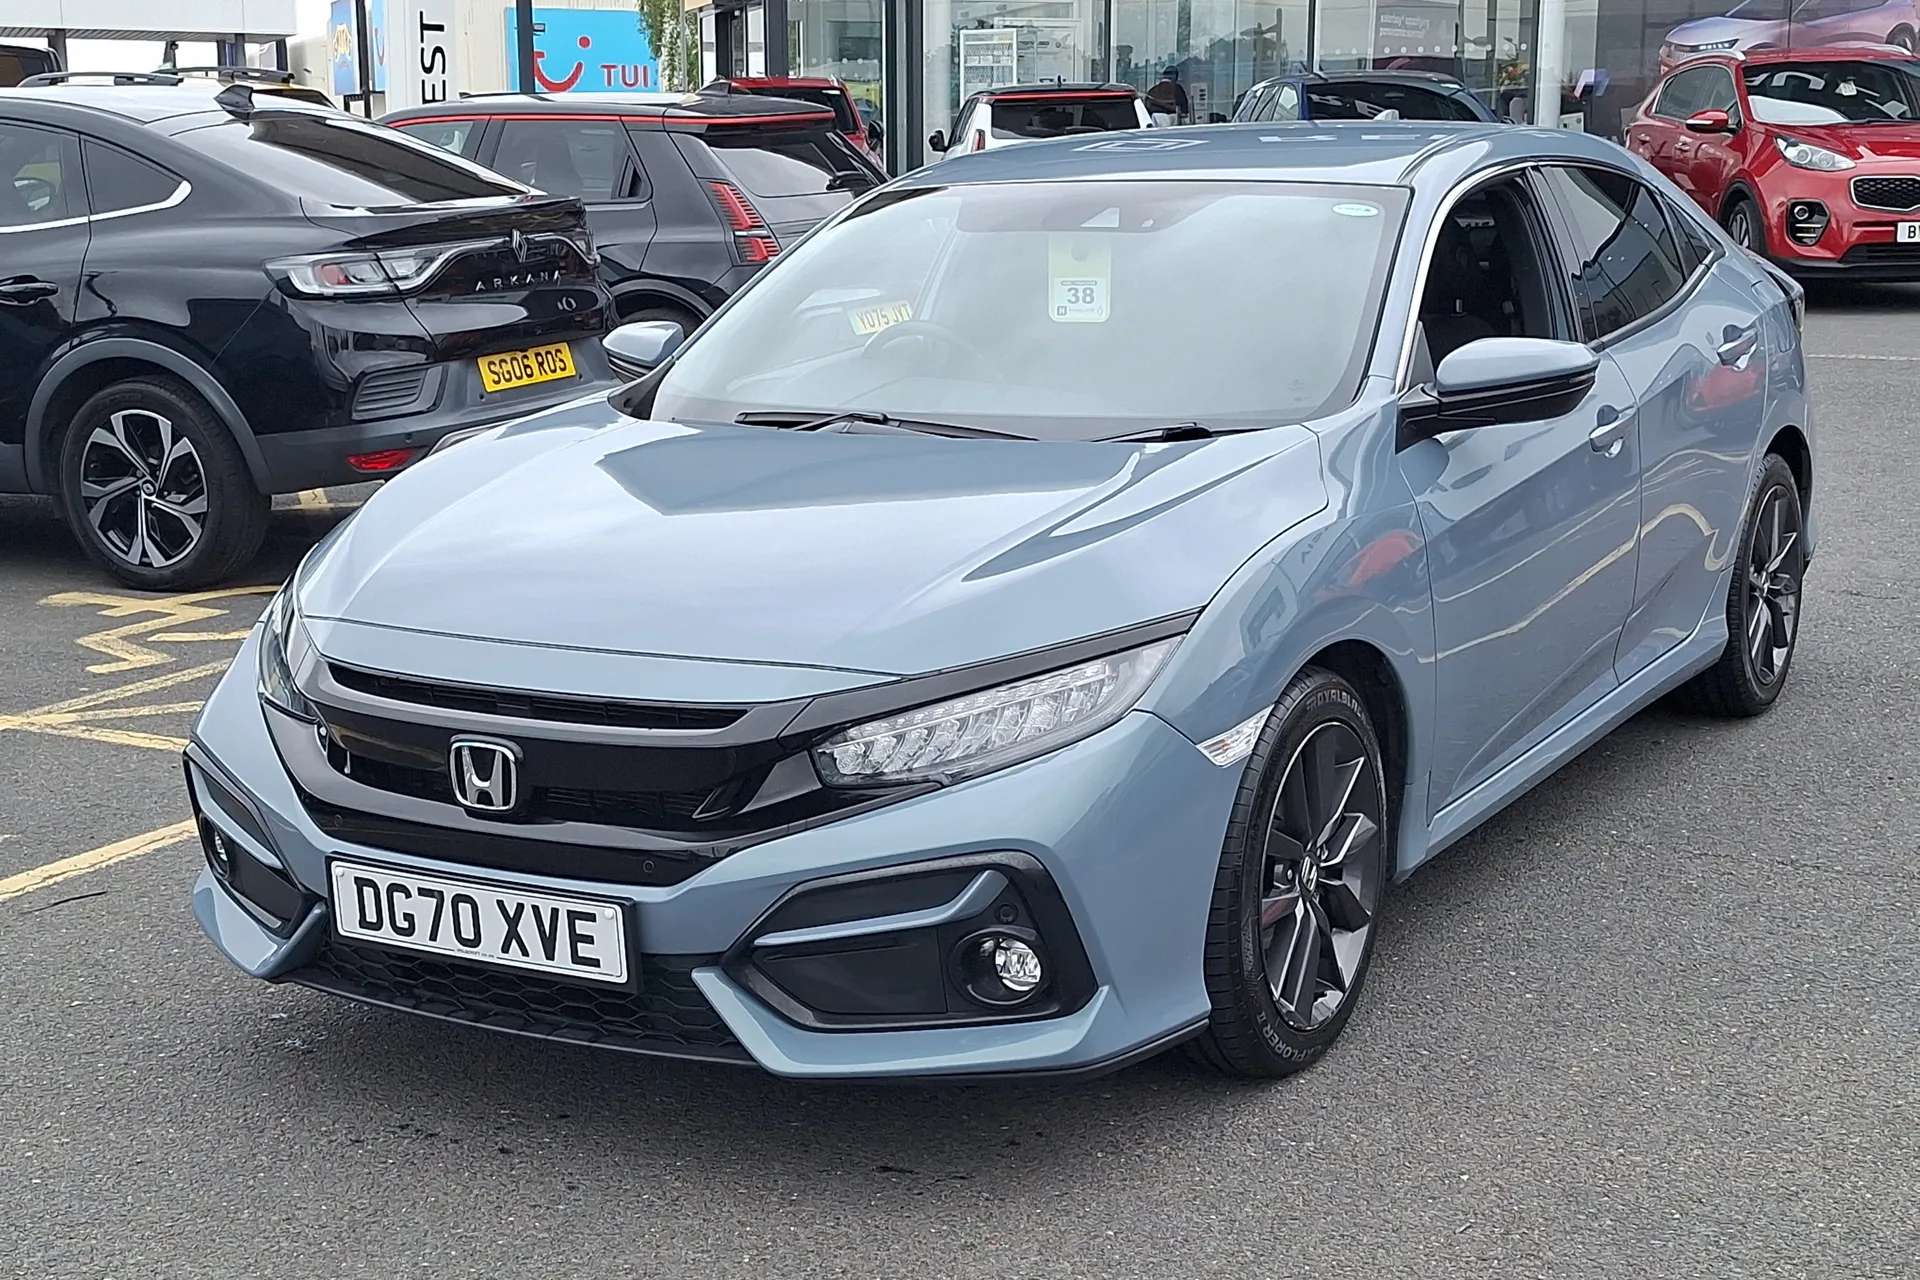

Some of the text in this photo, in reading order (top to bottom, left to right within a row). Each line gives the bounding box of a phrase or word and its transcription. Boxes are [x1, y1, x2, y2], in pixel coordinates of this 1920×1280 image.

[601, 64, 649, 88] TUI
[475, 270, 561, 291] ARKANA
[1067, 287, 1095, 304] 38
[487, 349, 567, 385] SG06 ROS
[353, 876, 601, 969] DG70 XVE
